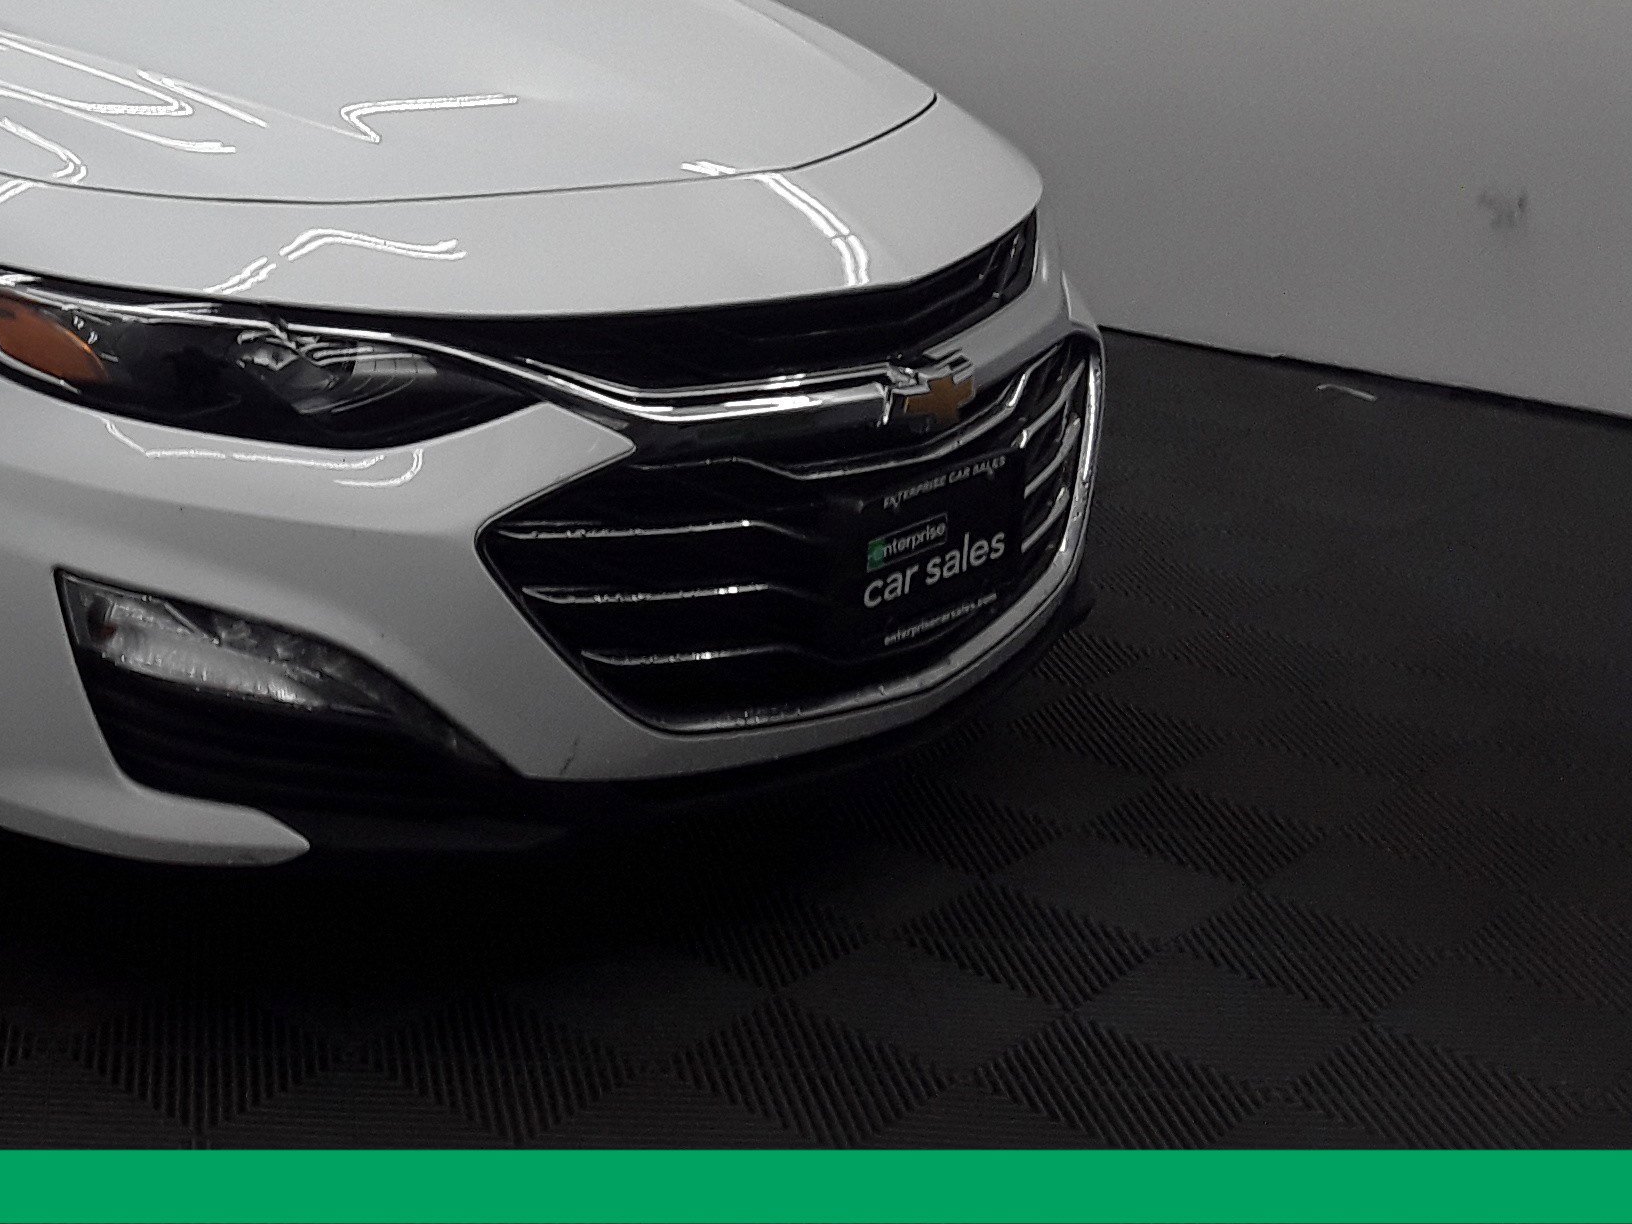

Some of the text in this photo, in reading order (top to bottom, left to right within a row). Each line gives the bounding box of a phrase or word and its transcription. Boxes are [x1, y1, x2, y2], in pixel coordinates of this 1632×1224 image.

[863, 531, 1006, 608] car sales
[869, 522, 946, 562] enterprise
